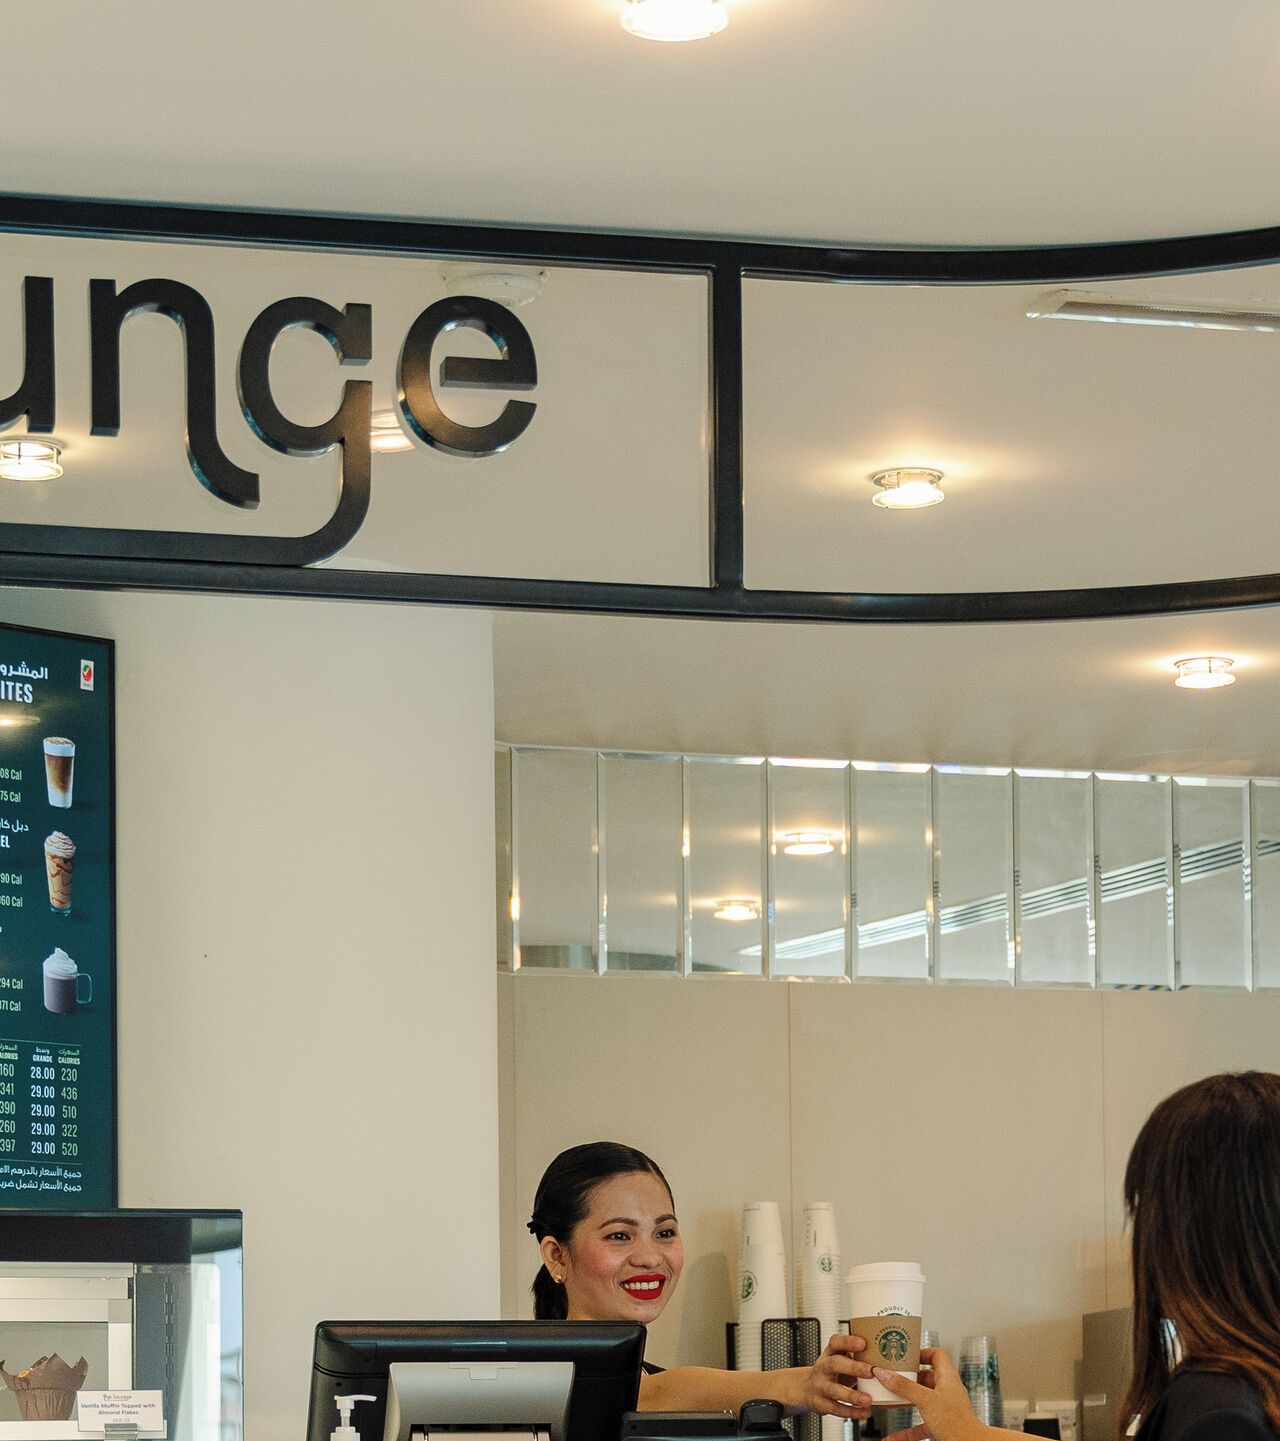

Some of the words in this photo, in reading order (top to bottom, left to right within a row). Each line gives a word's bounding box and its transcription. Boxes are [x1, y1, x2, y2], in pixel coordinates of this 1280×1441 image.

[31, 1066, 55, 1079] 28.00
[31, 1085, 54, 1098] 29.00
[31, 1104, 55, 1117] 29.00
